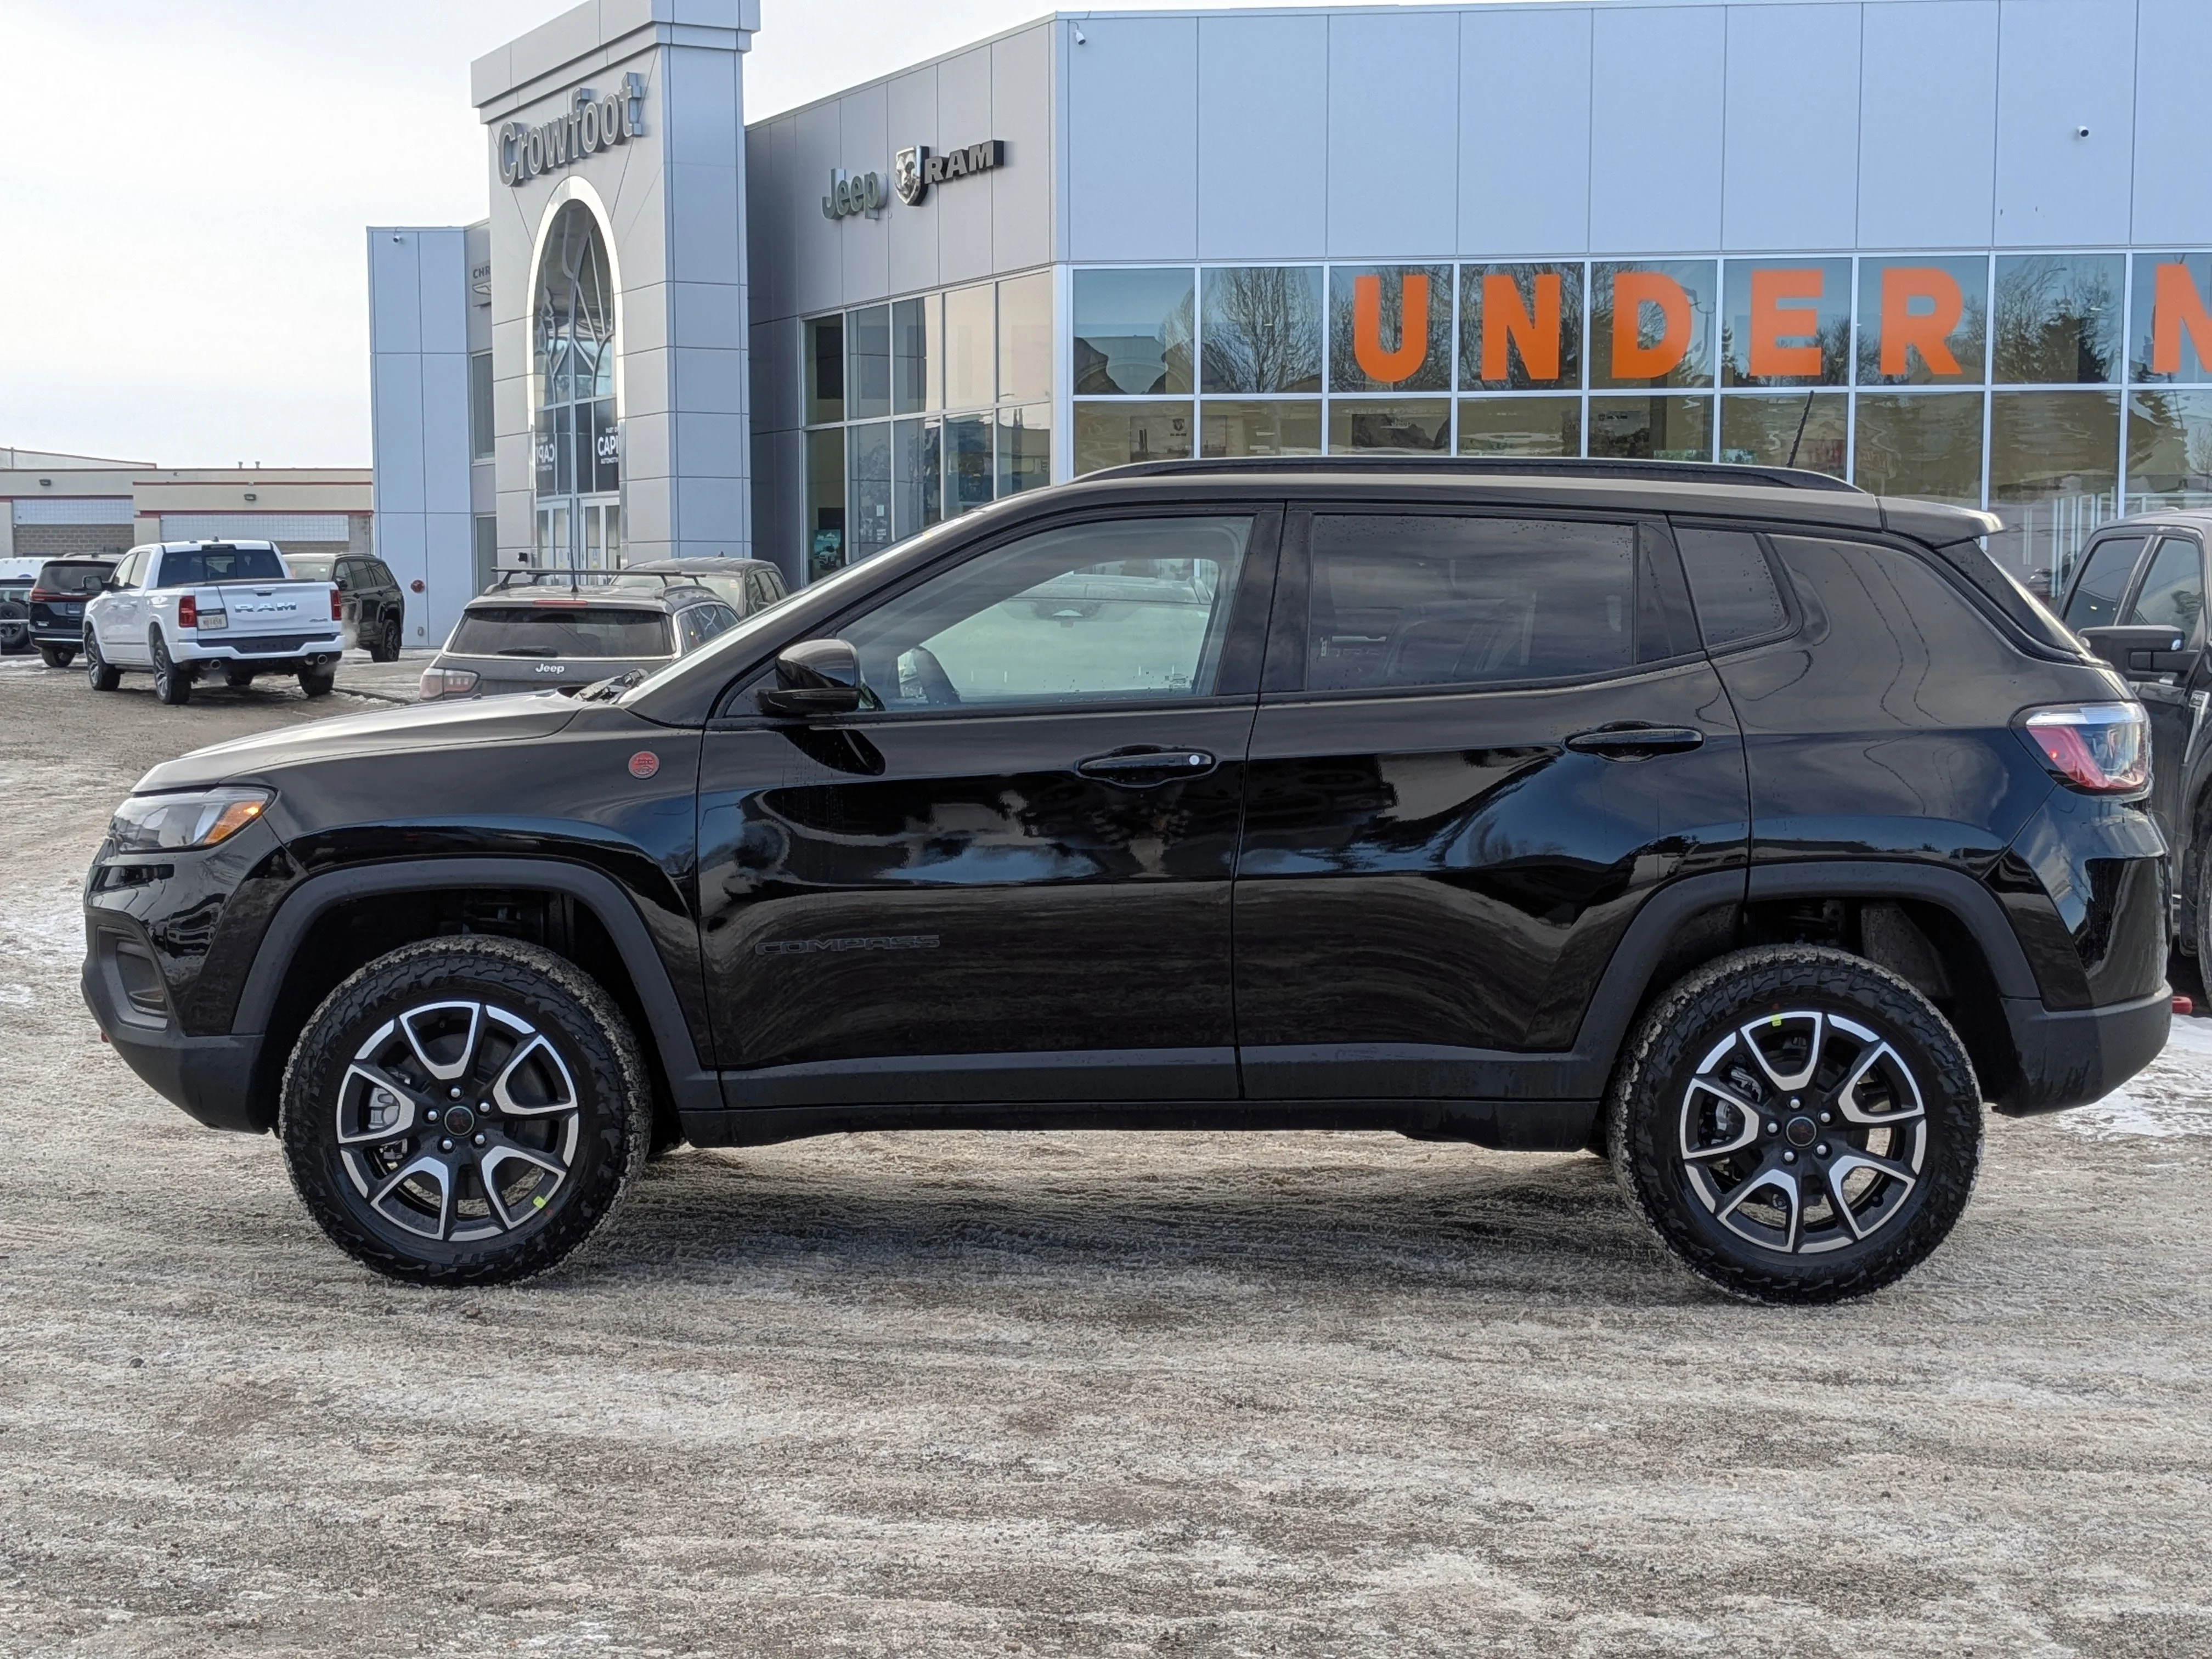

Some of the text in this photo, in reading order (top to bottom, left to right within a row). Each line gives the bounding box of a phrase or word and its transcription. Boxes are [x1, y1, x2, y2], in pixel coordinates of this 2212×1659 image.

[498, 72, 640, 187] Crowfoot
[924, 140, 1000, 184] RAM
[822, 168, 884, 219] Jeep
[473, 266, 490, 279] CHR
[1354, 269, 1961, 382] UNDER
[235, 602, 296, 613] RAM
[535, 663, 565, 674] Jeep
[755, 935, 940, 955] COMPASS
